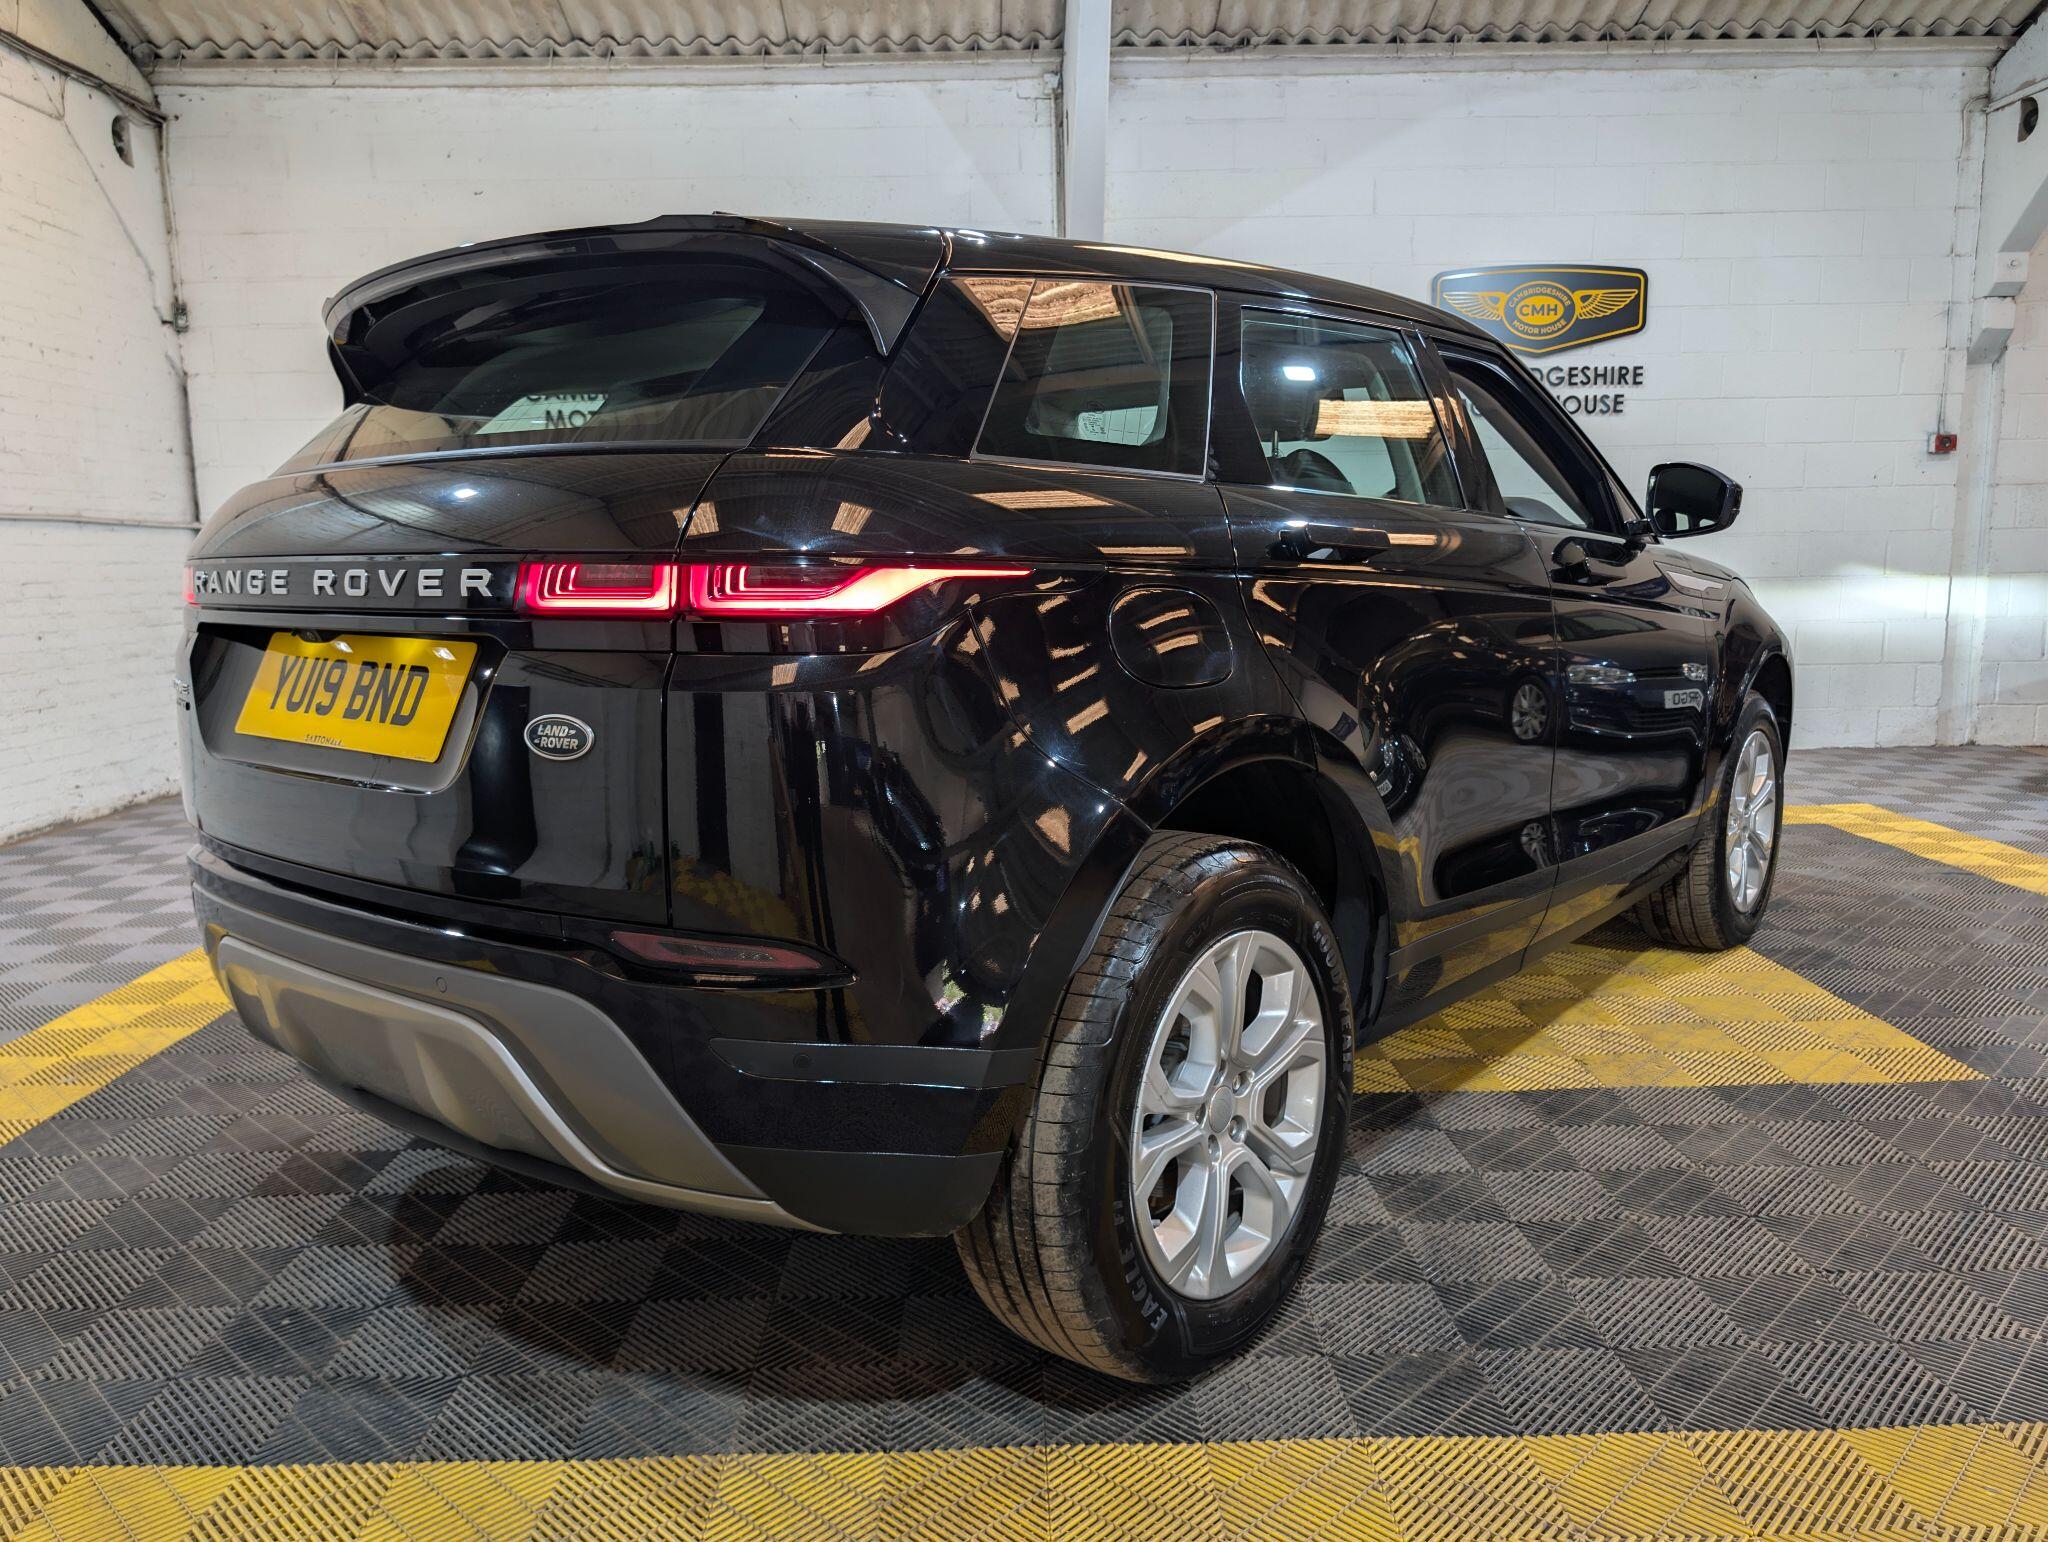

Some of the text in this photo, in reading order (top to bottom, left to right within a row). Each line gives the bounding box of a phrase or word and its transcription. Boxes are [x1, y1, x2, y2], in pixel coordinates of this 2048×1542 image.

[1519, 303, 1558, 317] CMH
[1513, 319, 1567, 334] MOTOR HOUSE
[1557, 394, 1625, 415] OUSE
[194, 568, 494, 598] RANGE ROVER
[270, 655, 430, 727] YU19 BND
[537, 724, 569, 738] LAND
[540, 736, 579, 750] ROVER
[1120, 1242, 1168, 1330] EAGLE
